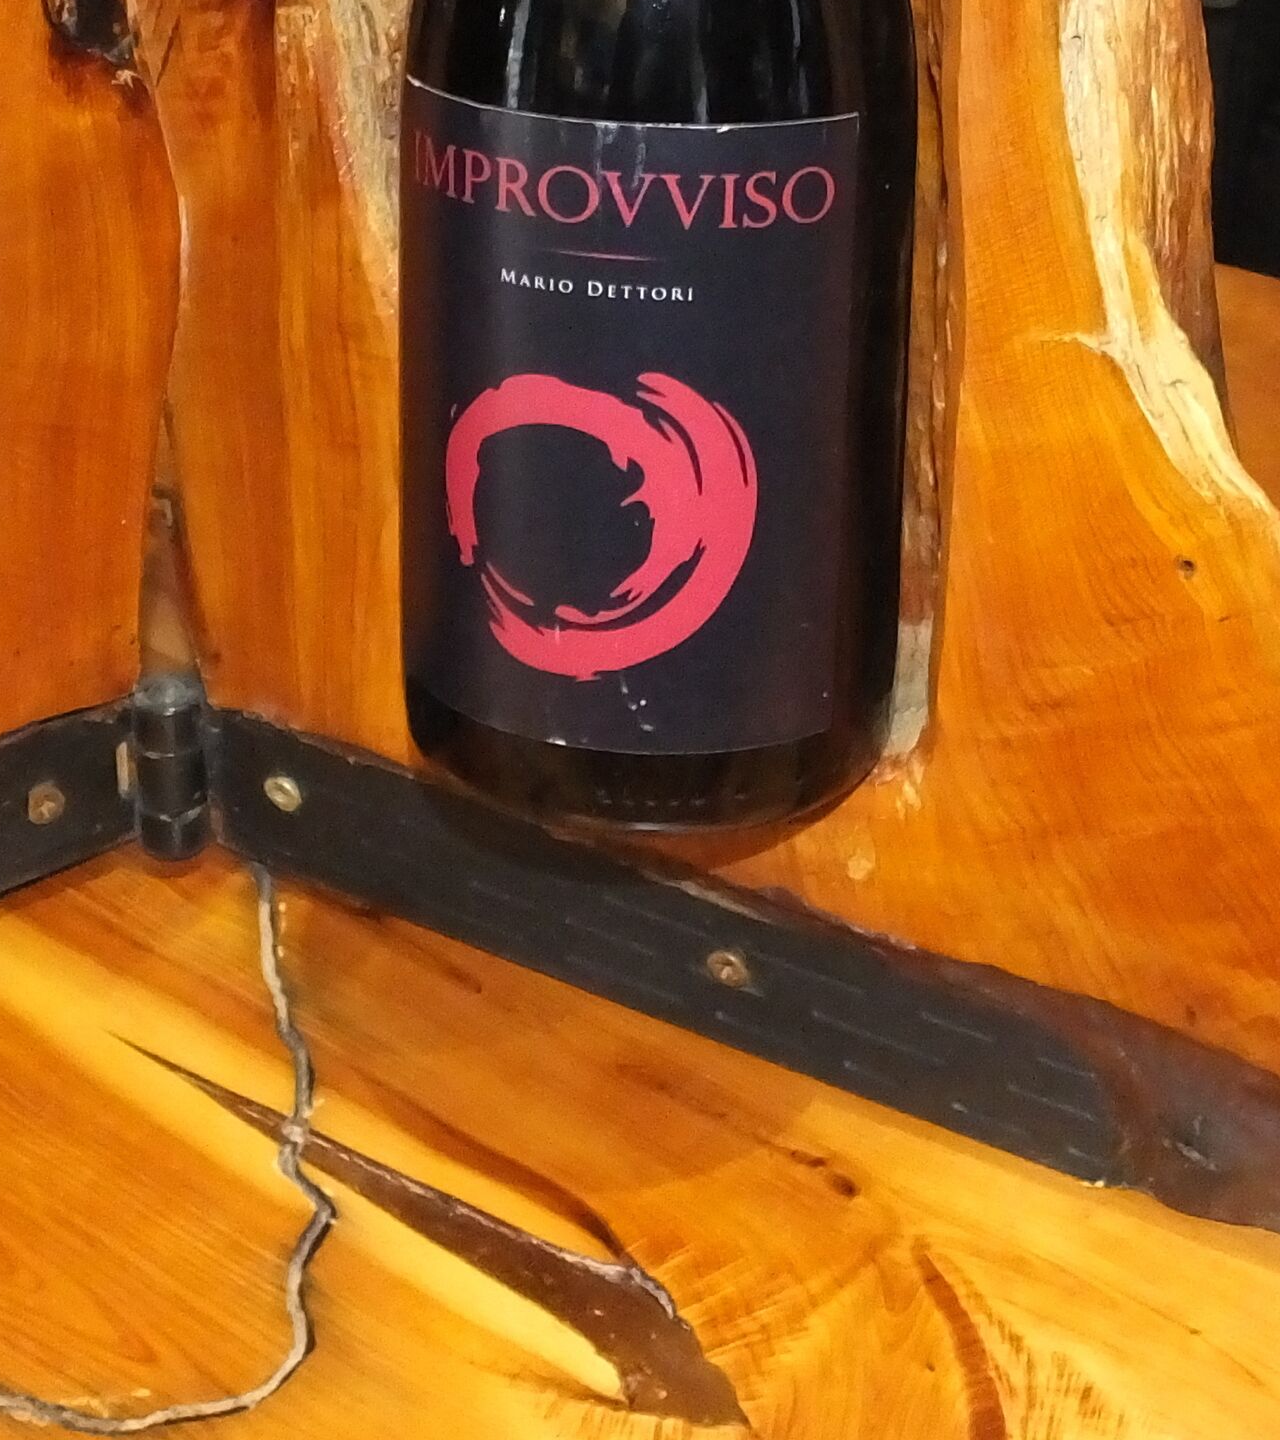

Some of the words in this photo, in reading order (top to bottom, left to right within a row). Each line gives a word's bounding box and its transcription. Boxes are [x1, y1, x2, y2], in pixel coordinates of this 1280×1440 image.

[412, 129, 837, 231] IMPROVVISO
[500, 268, 575, 294] MARIO
[587, 280, 694, 303] DETTORI
